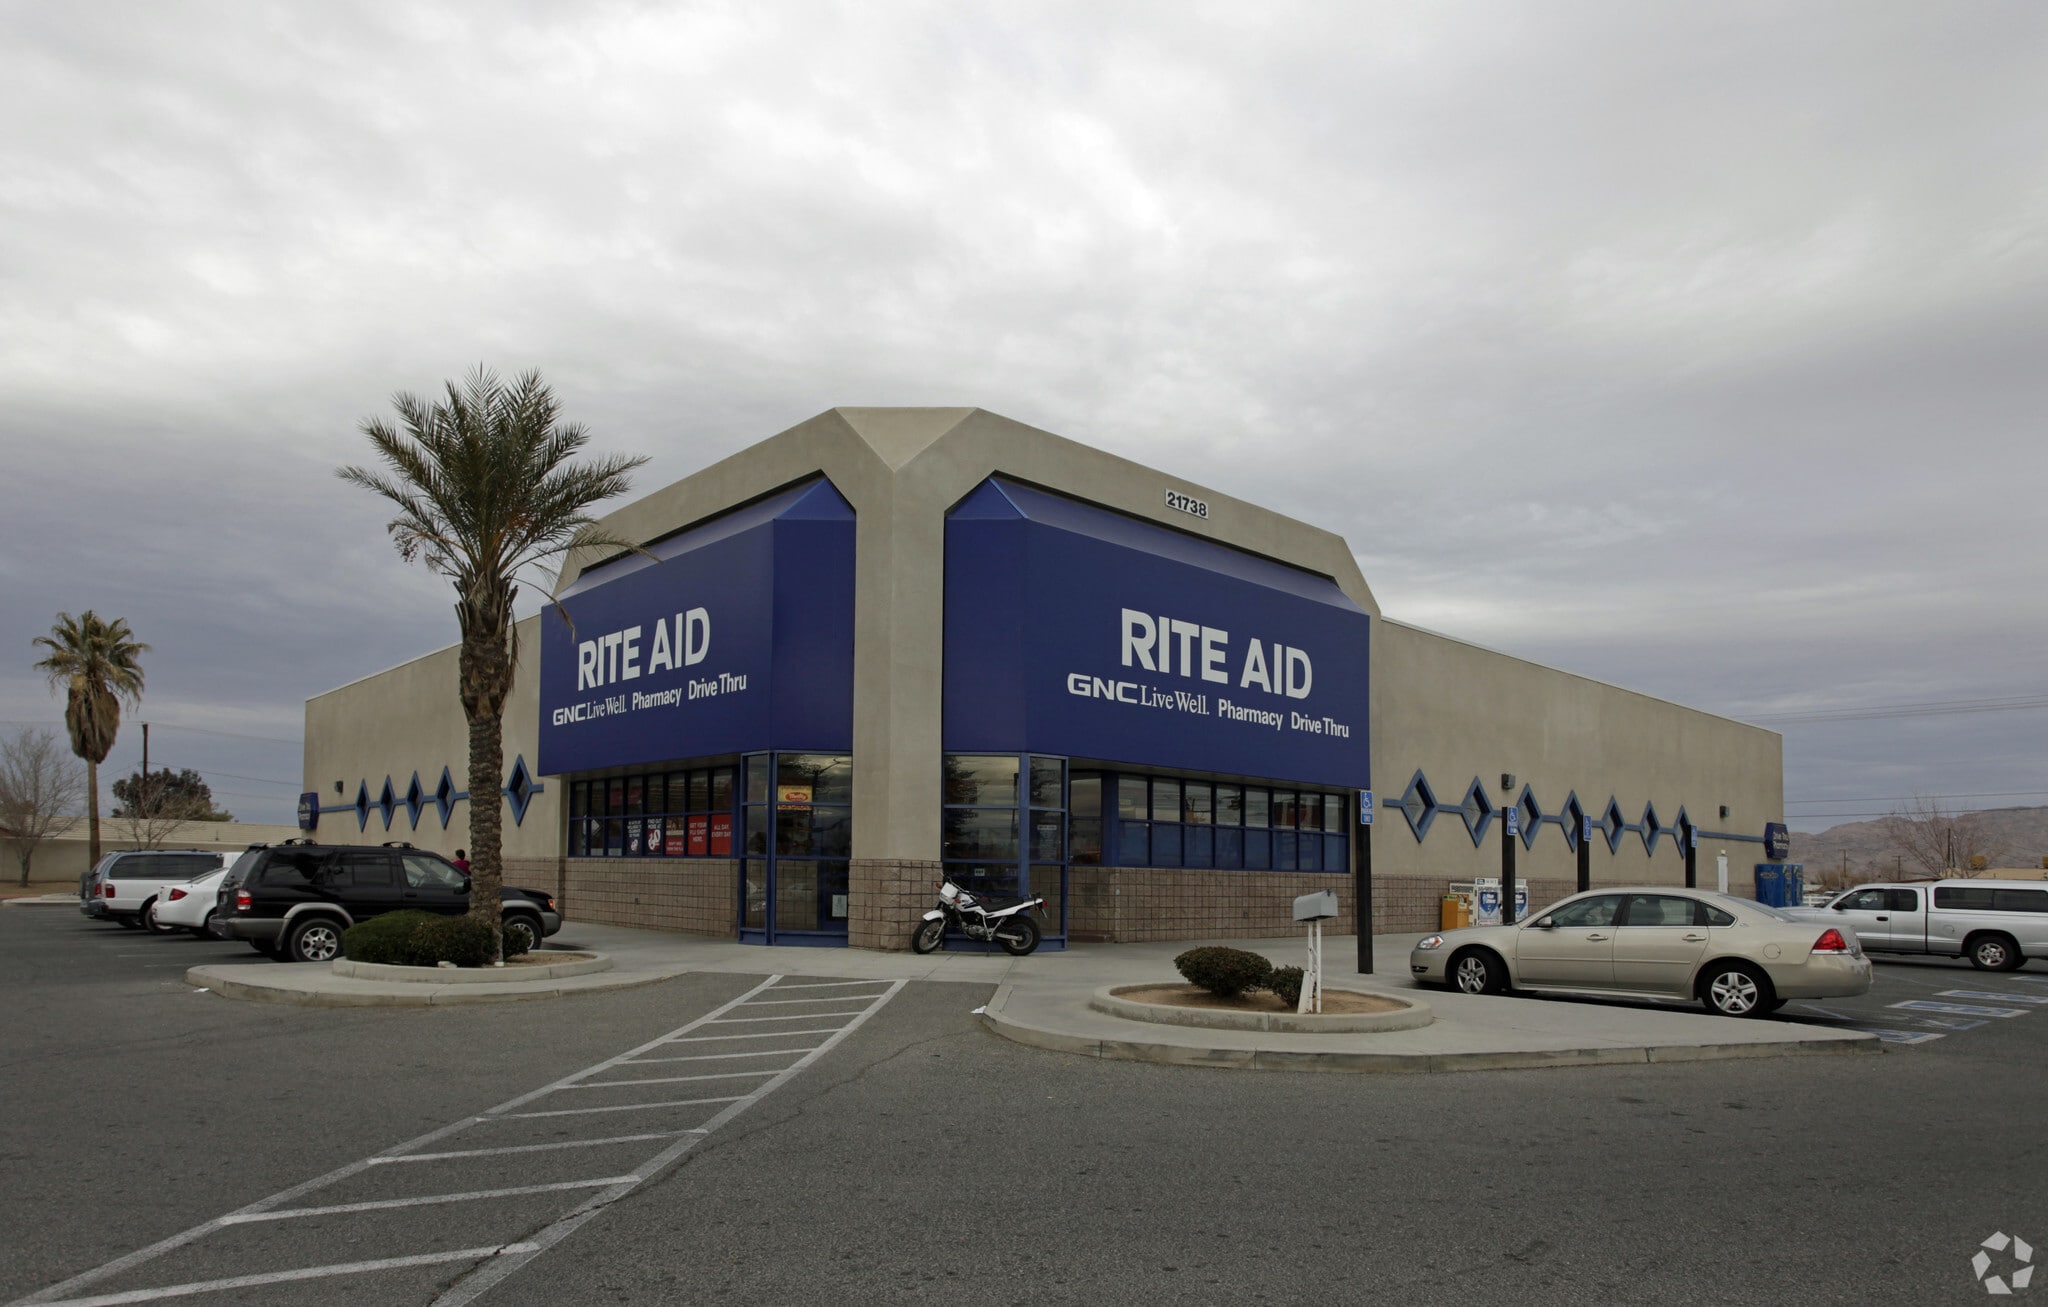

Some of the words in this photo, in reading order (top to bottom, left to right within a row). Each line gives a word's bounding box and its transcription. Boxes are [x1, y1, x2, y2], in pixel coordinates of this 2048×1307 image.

[1167, 492, 1207, 517] 21738
[577, 624, 642, 691] RITE
[648, 606, 711, 675] AID
[1121, 607, 1229, 685] RITE
[1239, 637, 1313, 700] AID
[552, 703, 587, 726] GNC
[632, 687, 682, 711] Pharmacy
[688, 677, 718, 700] Drive
[718, 672, 747, 694] Thru
[1067, 672, 1138, 704] GNC
[1218, 698, 1283, 731] Pharmacy
[1291, 711, 1322, 735] Drive
[1322, 716, 1350, 738] Thru
